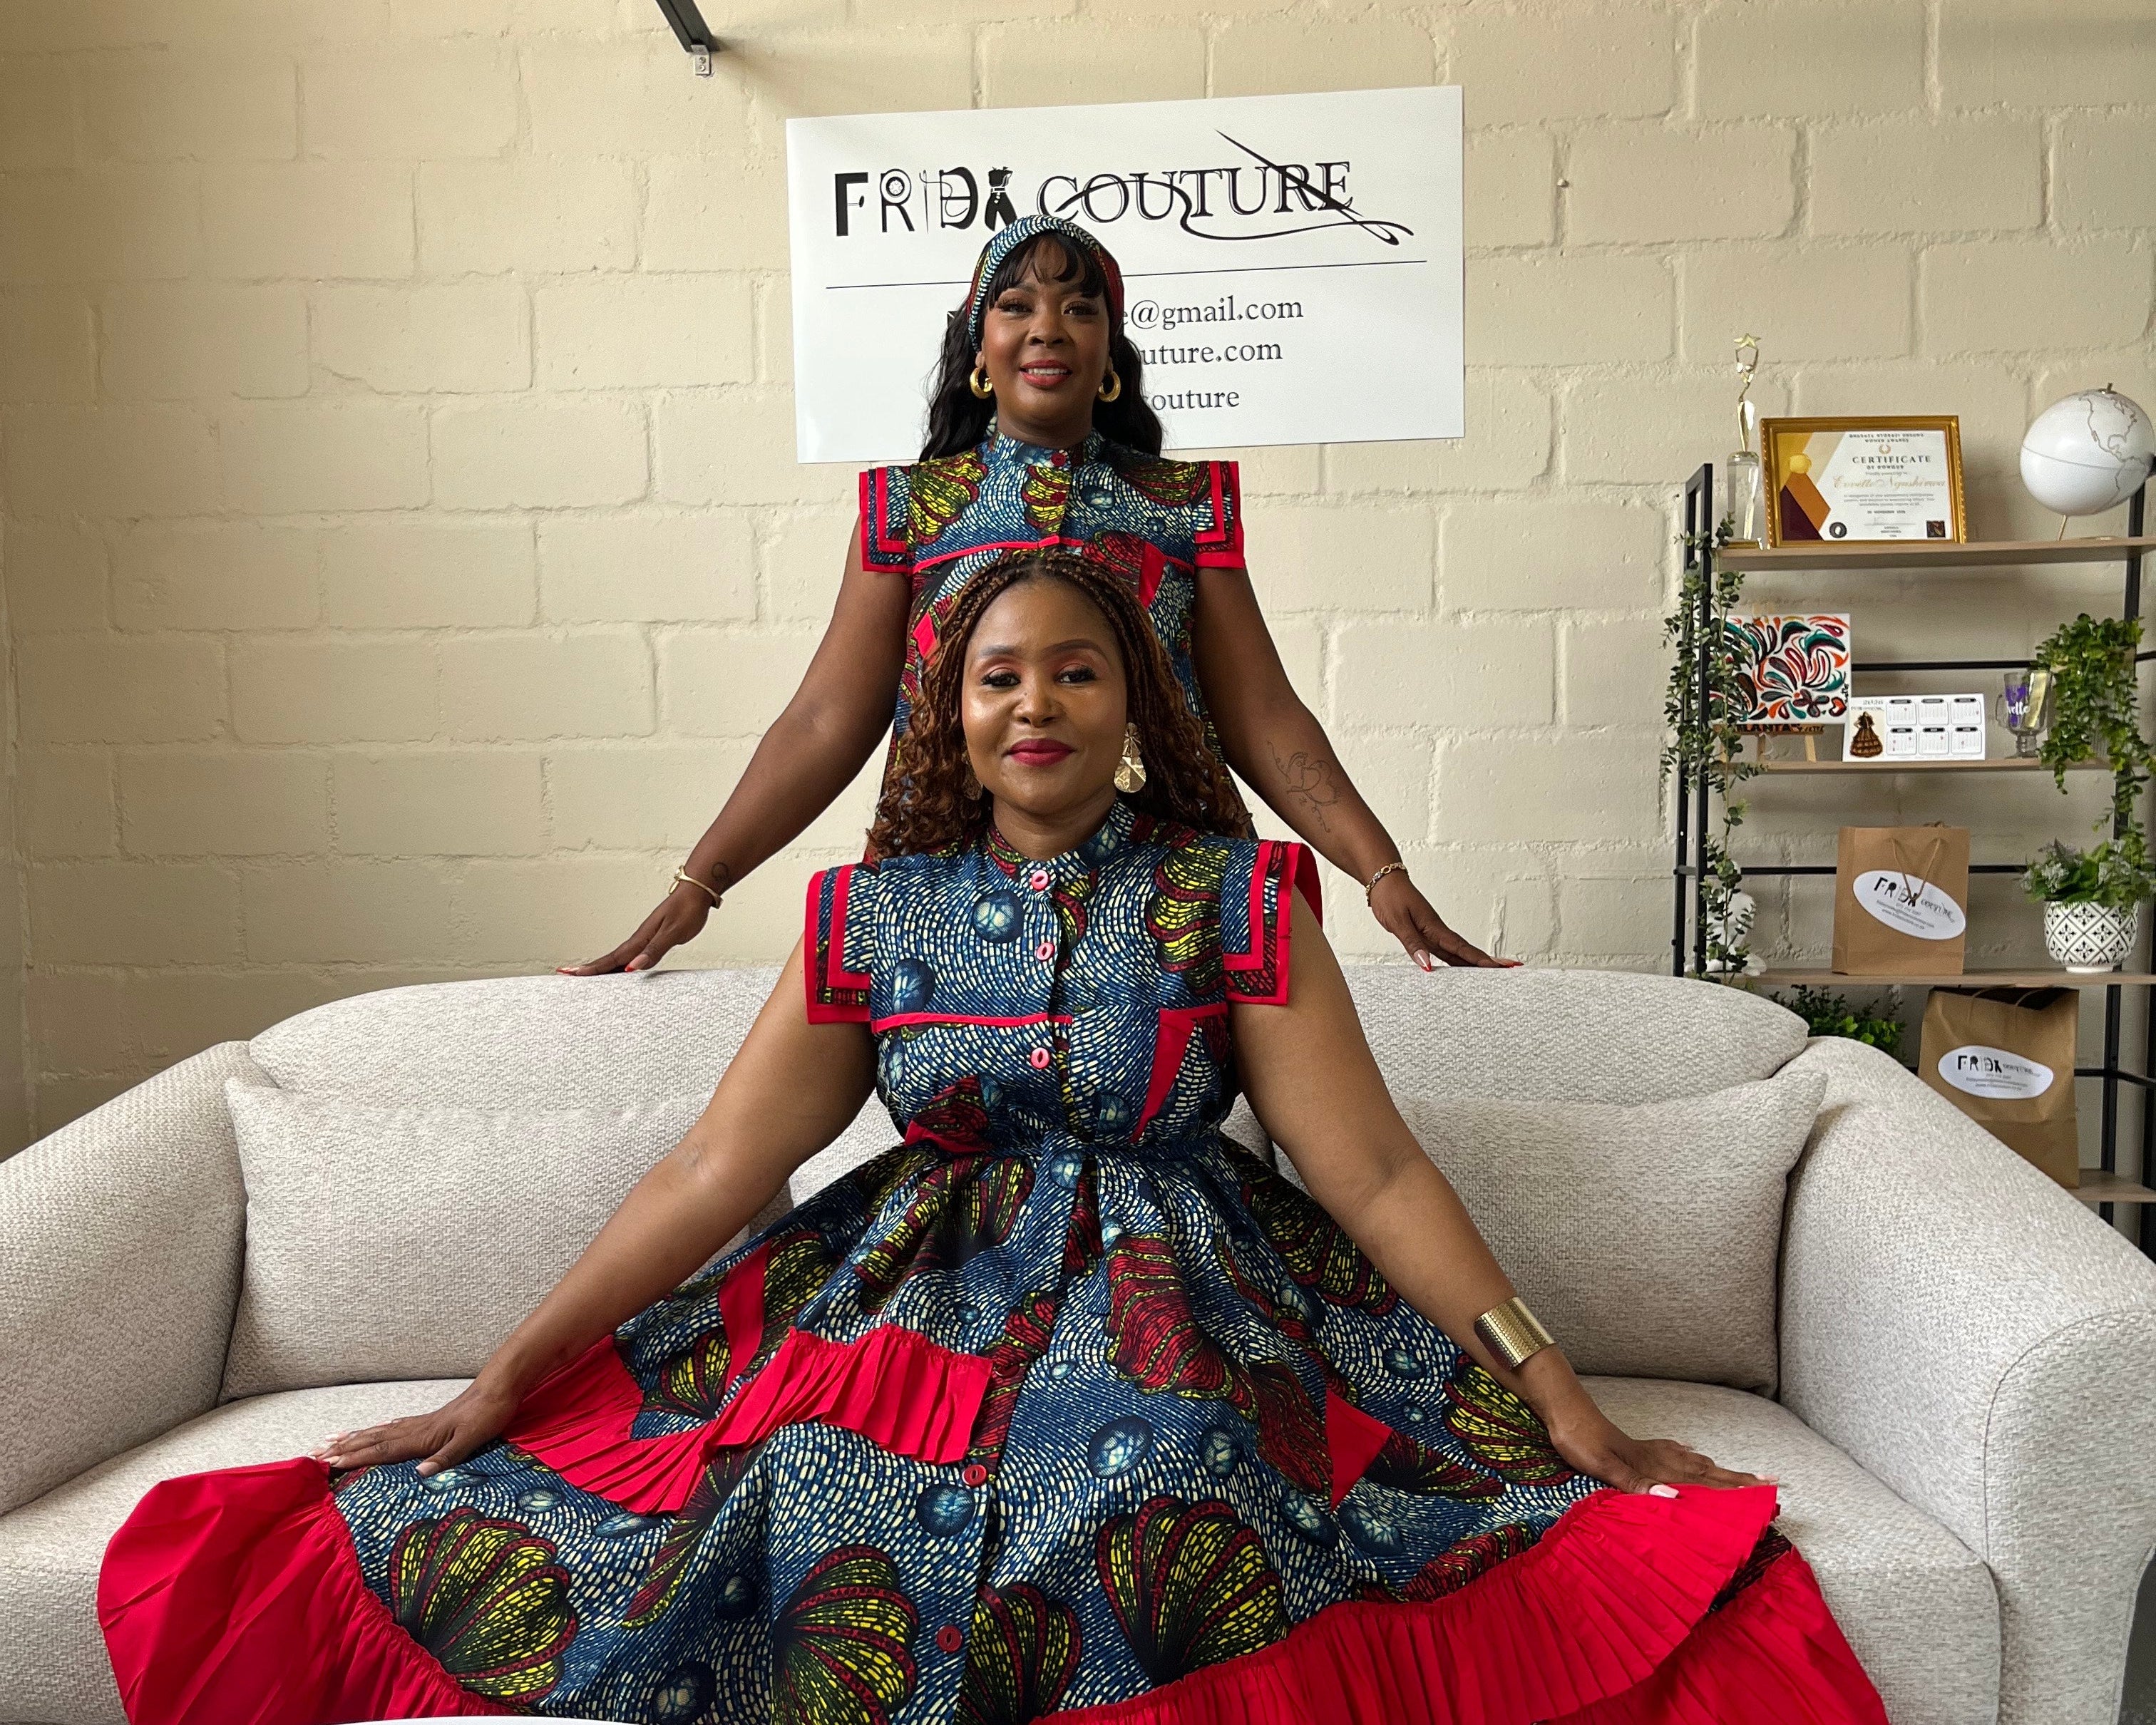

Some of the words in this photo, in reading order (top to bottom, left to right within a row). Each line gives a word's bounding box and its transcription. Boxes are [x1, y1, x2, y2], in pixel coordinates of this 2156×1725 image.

[835, 166, 1018, 236] FRIDA
[1035, 158, 1414, 245] COUTURE
[1140, 342, 1283, 365] uture.com
[1149, 390, 1240, 411] outure
[1852, 455, 1931, 463] CERTIFICATE
